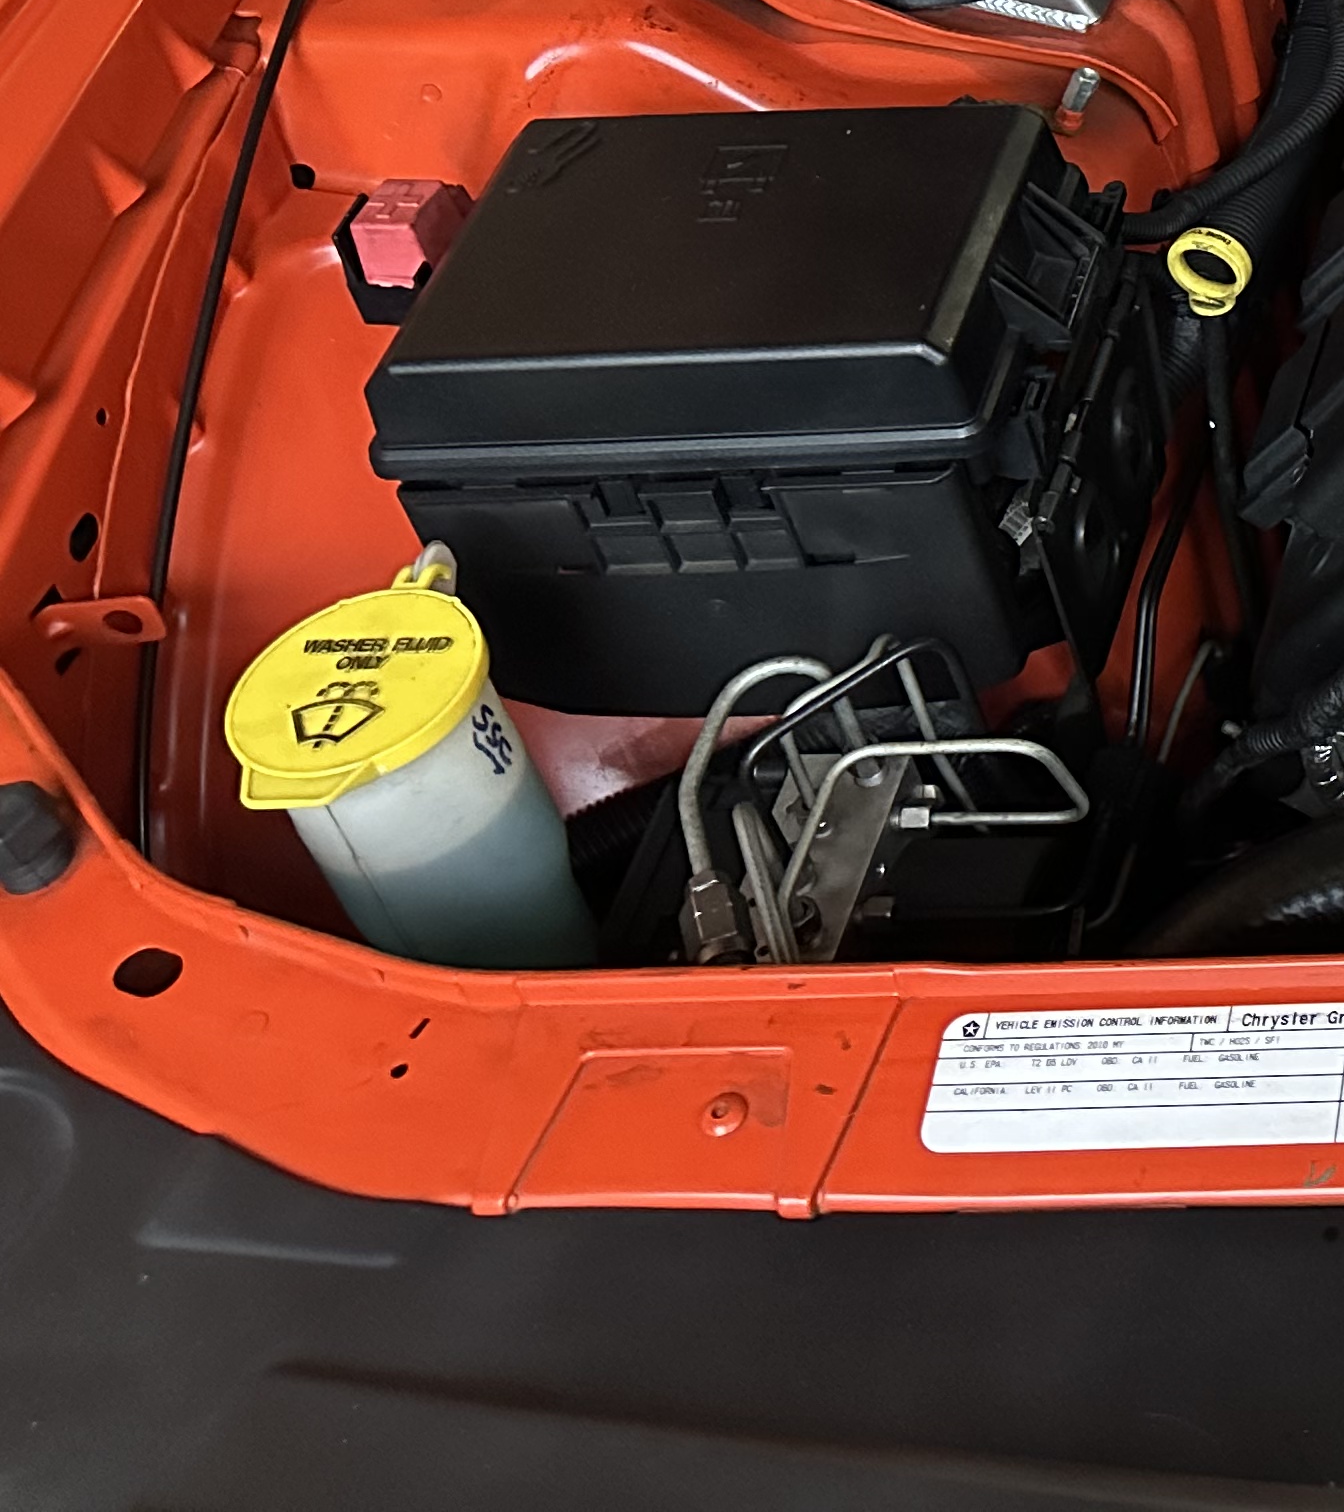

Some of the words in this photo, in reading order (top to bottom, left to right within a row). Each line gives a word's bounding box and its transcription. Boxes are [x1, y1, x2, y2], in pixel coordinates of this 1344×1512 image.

[303, 638, 389, 654] WASHER
[391, 637, 453, 652] FLUID
[336, 655, 389, 671] ONLY
[995, 1019, 1038, 1030] VEHICLE
[1043, 1017, 1093, 1029] EMISSION
[1099, 1016, 1142, 1027] CONTROL
[1149, 1015, 1217, 1026] INFORMATION
[1242, 1012, 1317, 1029] Chrysler
